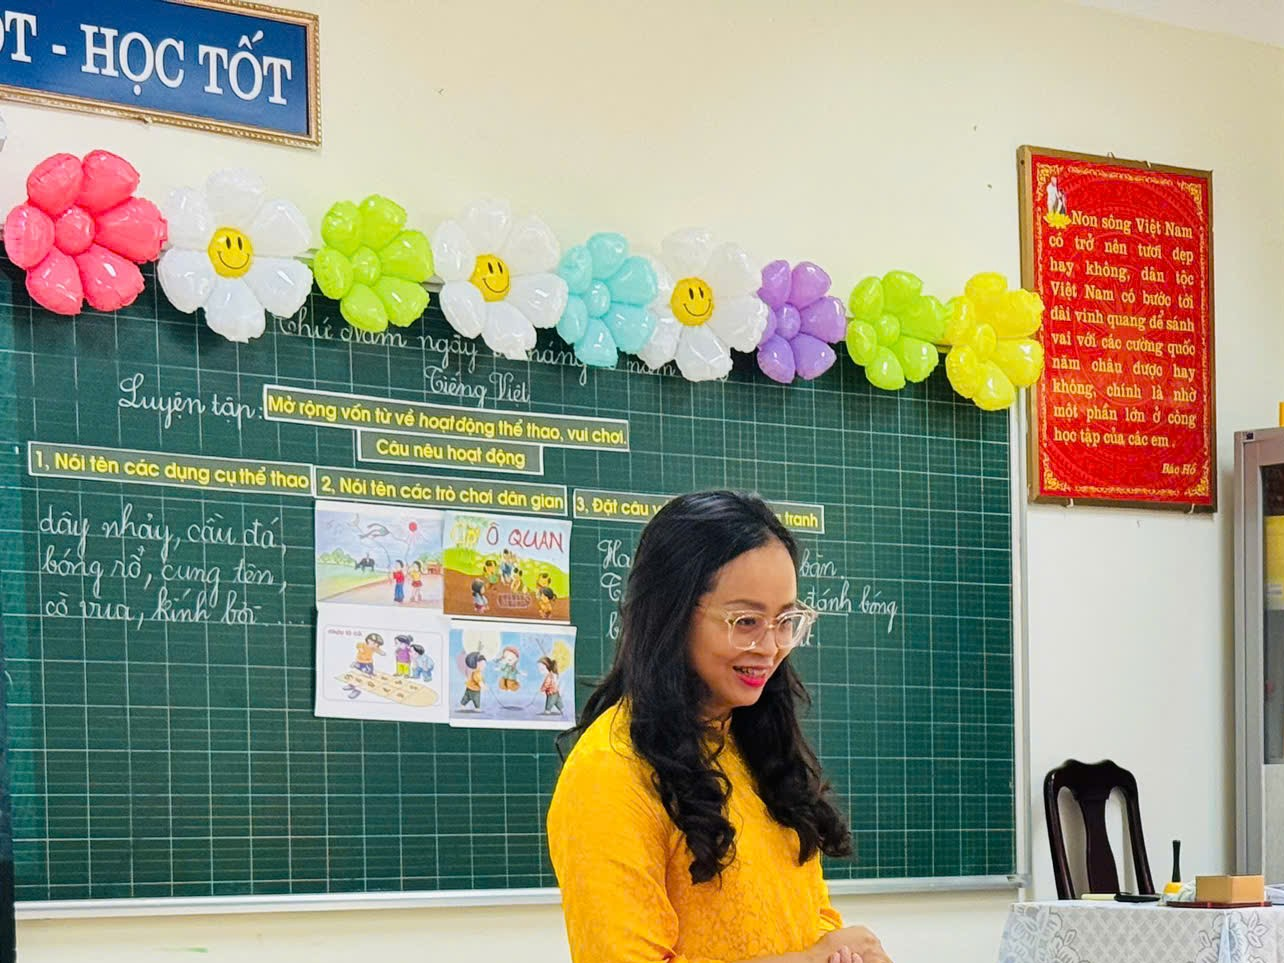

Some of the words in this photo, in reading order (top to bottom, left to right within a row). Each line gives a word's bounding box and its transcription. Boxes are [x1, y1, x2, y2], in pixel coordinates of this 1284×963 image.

[0, 10, 38, 63] T
[80, 24, 185, 96] HỌC
[198, 30, 292, 105] TỐT
[1071, 209, 1098, 228] Non
[1101, 215, 1132, 237] sông
[1135, 217, 1162, 239] Việt
[1165, 221, 1193, 239] Nam
[1049, 232, 1064, 248] có
[1074, 232, 1095, 252] trở
[1104, 236, 1128, 255] nên
[1138, 243, 1163, 259] tươi
[1049, 257, 1074, 275] hay
[1085, 260, 1130, 283] không,
[1141, 267, 1165, 283] dân
[1175, 270, 1195, 289] tộc
[1050, 280, 1078, 302] Việt
[1085, 284, 1115, 302] Nam
[1121, 289, 1136, 304] có
[1143, 290, 1172, 307] bước
[1178, 292, 1195, 309] tới
[1075, 308, 1105, 324] vinh
[1107, 313, 1147, 332] quang
[1166, 316, 1195, 332] sánh
[1051, 333, 1072, 346] vai
[1076, 332, 1096, 348] với
[1101, 334, 1122, 349] các
[1126, 337, 1164, 357] cường
[1167, 339, 1196, 358] quốc
[1052, 356, 1080, 371] năm
[1091, 358, 1123, 373] châu
[1132, 360, 1163, 380] được
[1172, 364, 1196, 382] hay
[118, 373, 206, 429] Luyện
[424, 366, 488, 409] Tiếng
[489, 372, 531, 408] Việt
[1052, 379, 1097, 398] không,
[1106, 383, 1142, 400] chính
[1152, 385, 1164, 400] là
[1173, 387, 1197, 402] nhờ
[268, 395, 296, 413] Mở
[300, 401, 337, 422] rộng
[342, 404, 371, 422] vốn
[375, 407, 393, 425] từ
[395, 409, 415, 427] về
[499, 419, 523, 438] thể
[527, 424, 563, 442] thao,
[567, 429, 589, 442] vui
[592, 428, 627, 445] chơi.
[1053, 404, 1078, 421] một
[1125, 407, 1145, 422] lớn
[1152, 406, 1162, 423] ở
[1054, 427, 1077, 447] học
[1080, 429, 1101, 448] tập
[1103, 427, 1125, 446] của
[1128, 431, 1149, 446] các
[376, 438, 410, 457] Câu
[413, 443, 443, 459] nêu
[447, 445, 482, 465] hoạt
[485, 448, 526, 469] động
[1161, 463, 1180, 475] Bác
[55, 452, 86, 471] Nói
[89, 455, 119, 474] tên
[124, 458, 160, 477] các
[164, 462, 210, 485] dụng
[214, 469, 237, 487] cụ
[239, 466, 267, 486] thể
[270, 470, 309, 489] thao
[340, 477, 367, 496] Nói
[370, 480, 397, 498] tên
[400, 483, 432, 500] các
[435, 485, 457, 501] trò
[459, 487, 493, 504] chơi
[497, 489, 528, 507] dân
[531, 493, 564, 512] gian
[592, 497, 618, 516] Đặt
[621, 501, 649, 516] câu
[40, 504, 90, 560] dây
[101, 503, 181, 564] nhảy,
[187, 512, 237, 546] cầu
[785, 510, 818, 528] tranh
[486, 522, 500, 546] Ô
[508, 528, 564, 553] QUAN
[41, 545, 104, 599] bóng
[161, 564, 220, 609] cung
[45, 591, 69, 617] cờ
[79, 600, 145, 631] vua,
[150, 586, 211, 623] kính
[803, 580, 852, 612] đánh
[859, 584, 898, 634] bóng
